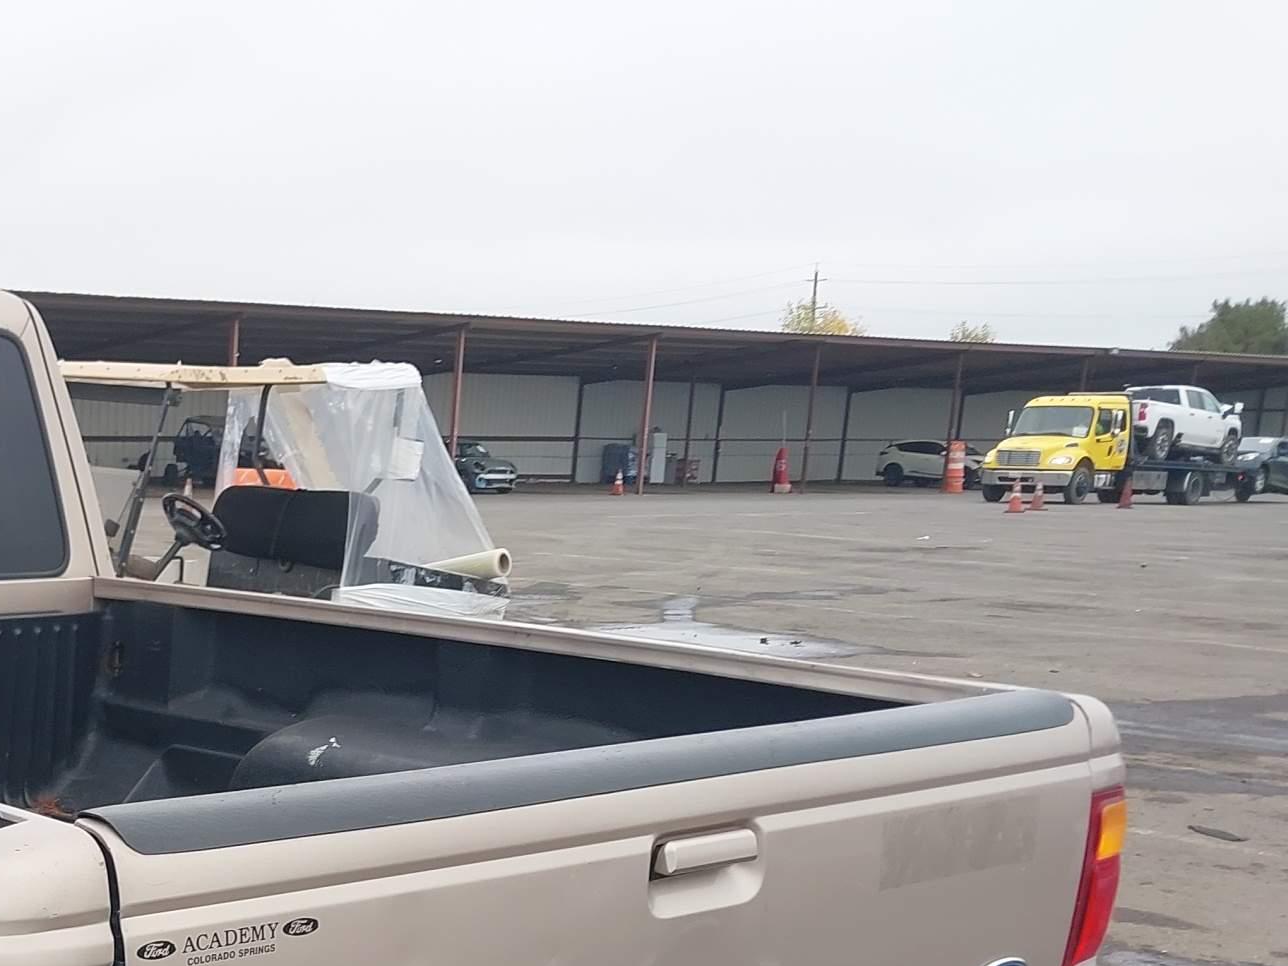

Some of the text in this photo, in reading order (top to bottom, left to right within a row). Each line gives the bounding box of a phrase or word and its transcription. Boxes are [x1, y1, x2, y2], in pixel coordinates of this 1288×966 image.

[182, 922, 279, 953] ACADEMY
[187, 943, 276, 966] COLORADO SPRINGS
